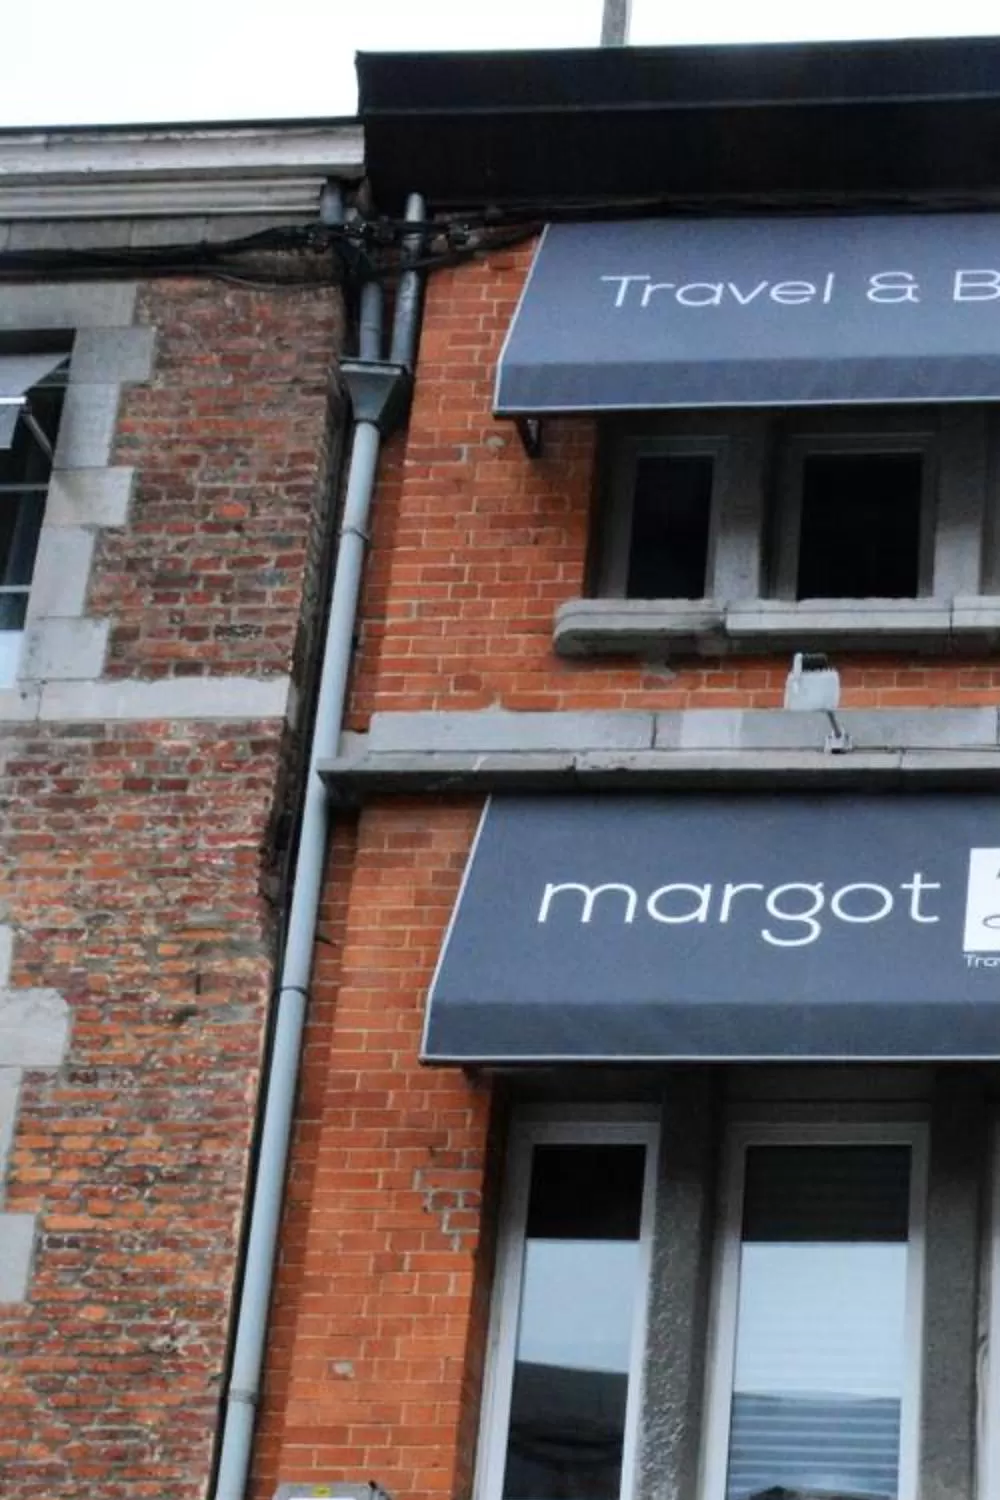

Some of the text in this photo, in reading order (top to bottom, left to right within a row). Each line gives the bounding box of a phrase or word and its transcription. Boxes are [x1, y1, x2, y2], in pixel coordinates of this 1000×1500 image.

[601, 273, 834, 307] Travel
[866, 272, 920, 304] &
[538, 872, 940, 946] margot
